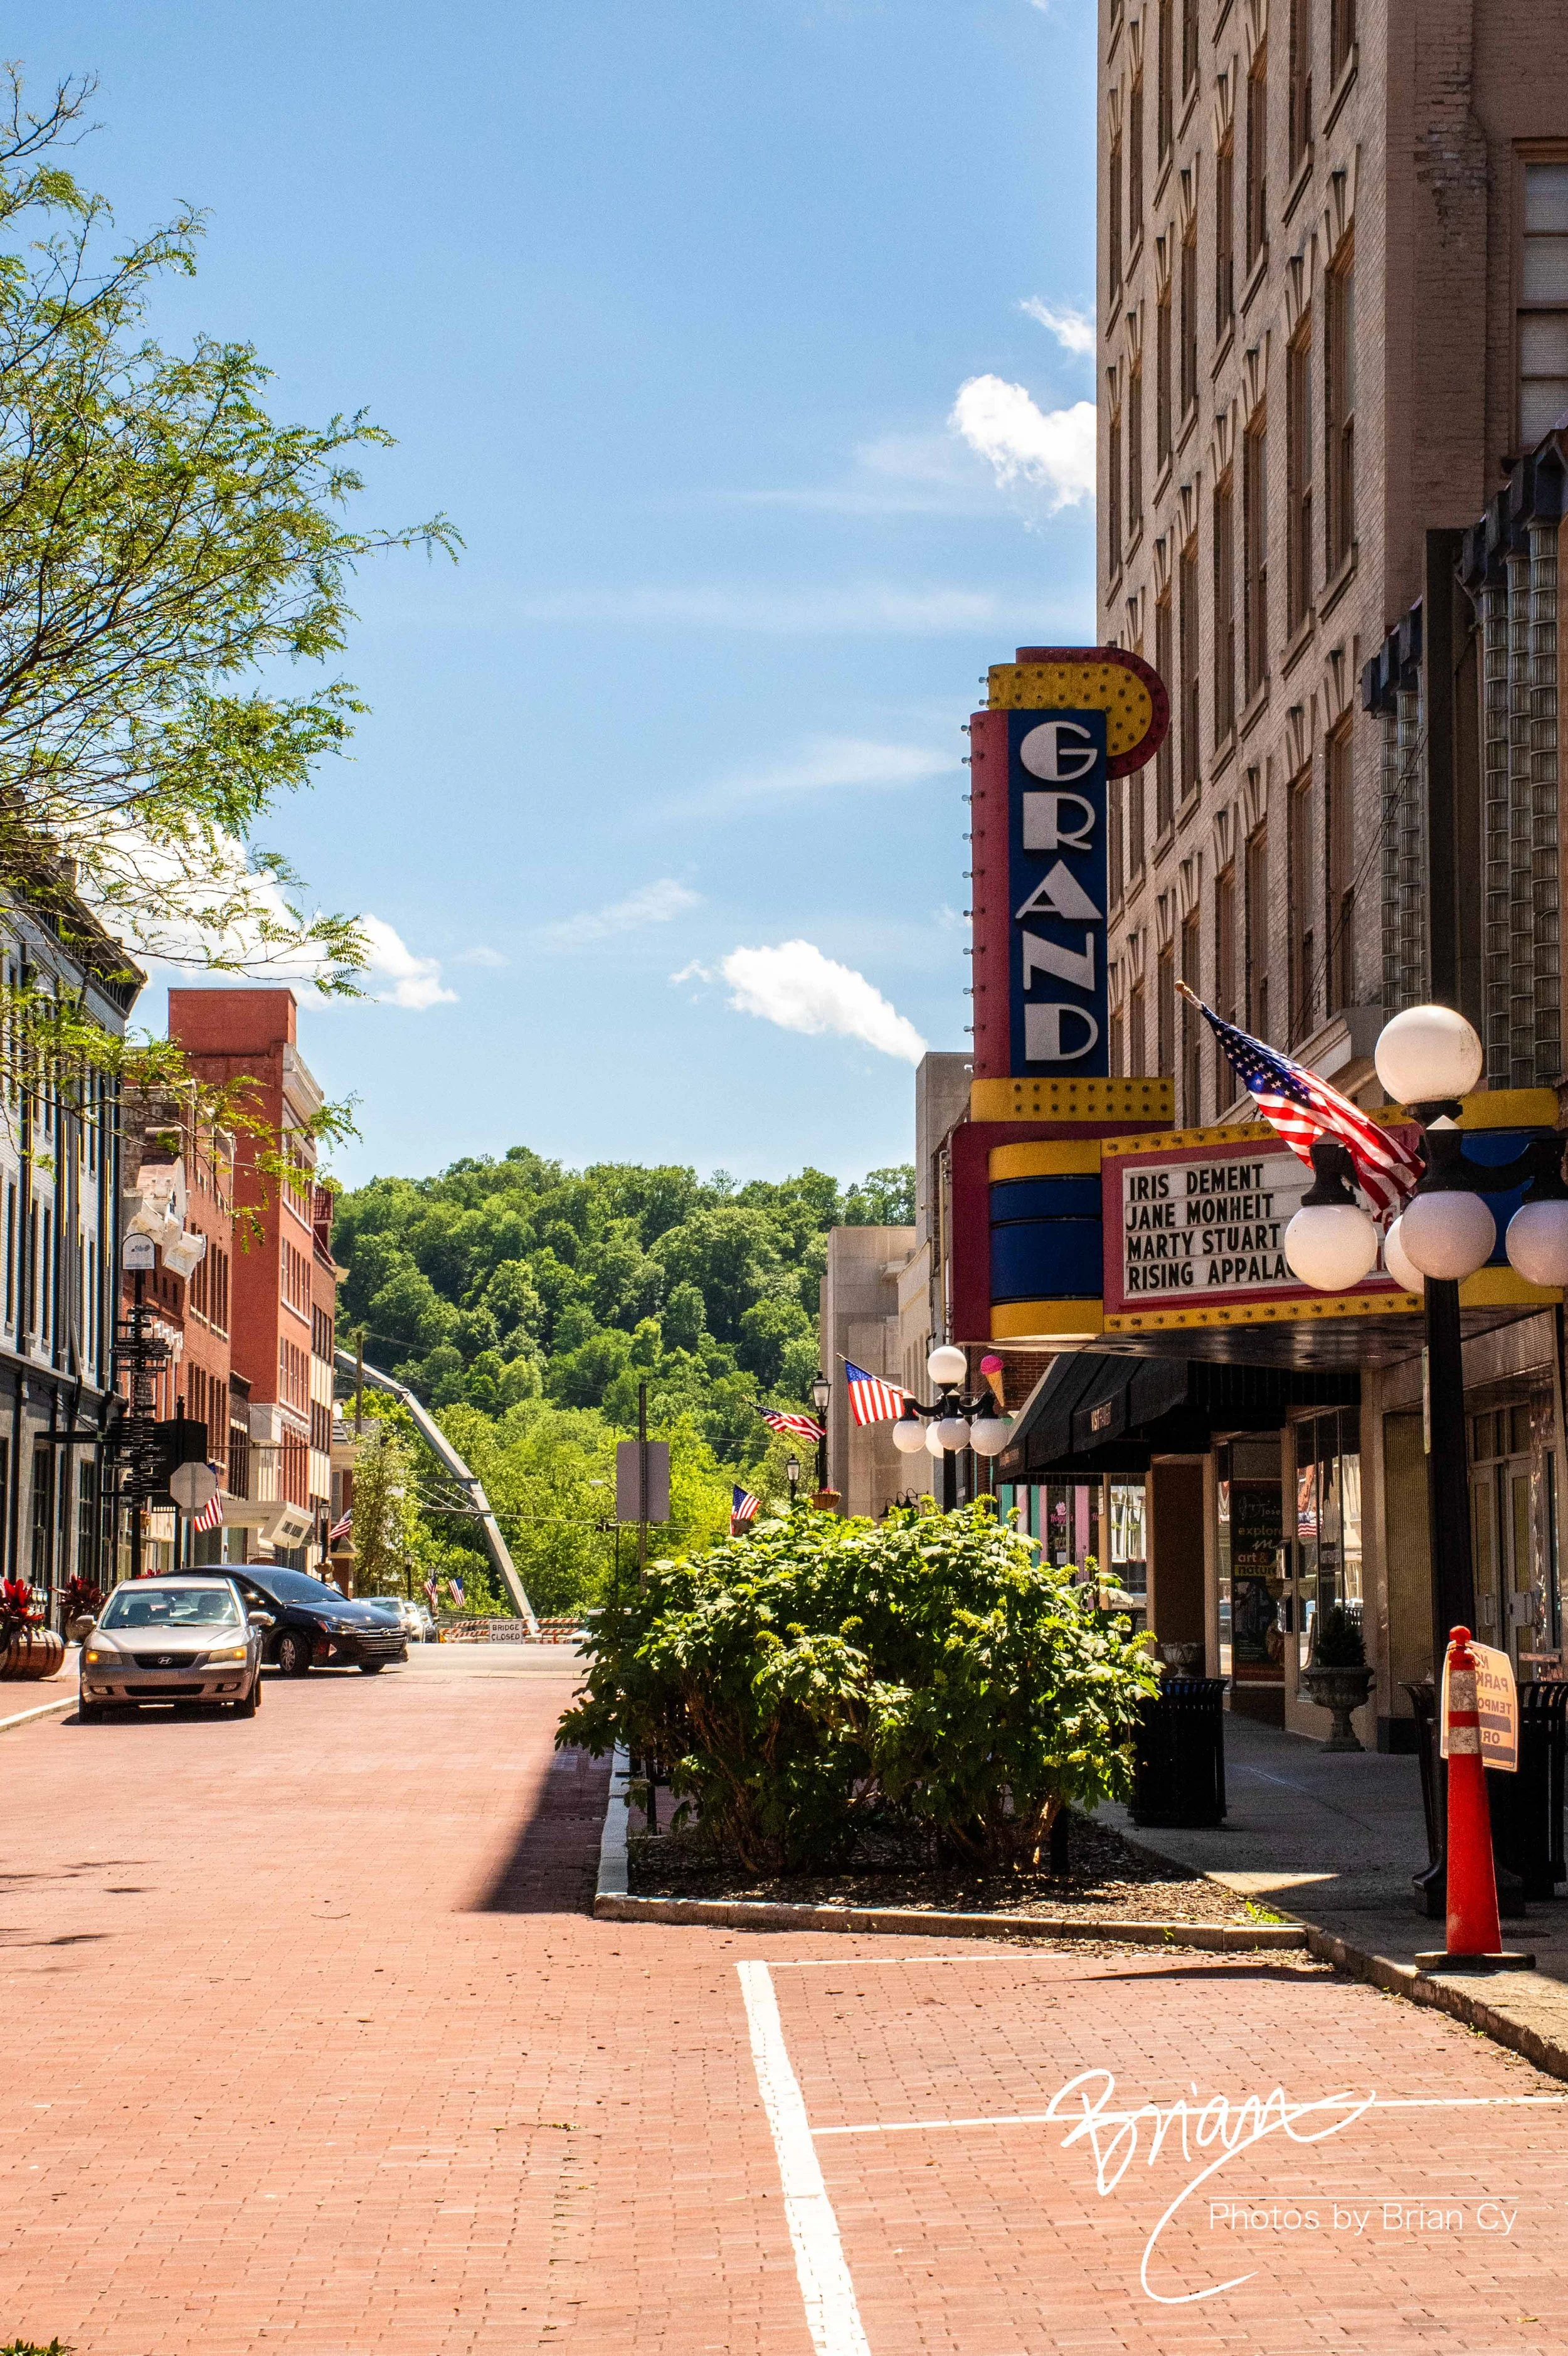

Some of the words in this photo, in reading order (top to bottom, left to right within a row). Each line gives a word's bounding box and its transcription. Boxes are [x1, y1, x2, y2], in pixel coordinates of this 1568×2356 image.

[1015, 720, 1103, 1061] GRAND
[1130, 1174, 1169, 1201] IRIS
[1187, 1164, 1263, 1194] DEMENT
[1126, 1202, 1175, 1230] JANE
[1187, 1193, 1273, 1225] MONHEIT
[1128, 1231, 1194, 1260] MARTY
[1202, 1223, 1280, 1254] STUART
[1129, 1261, 1194, 1290] RISING
